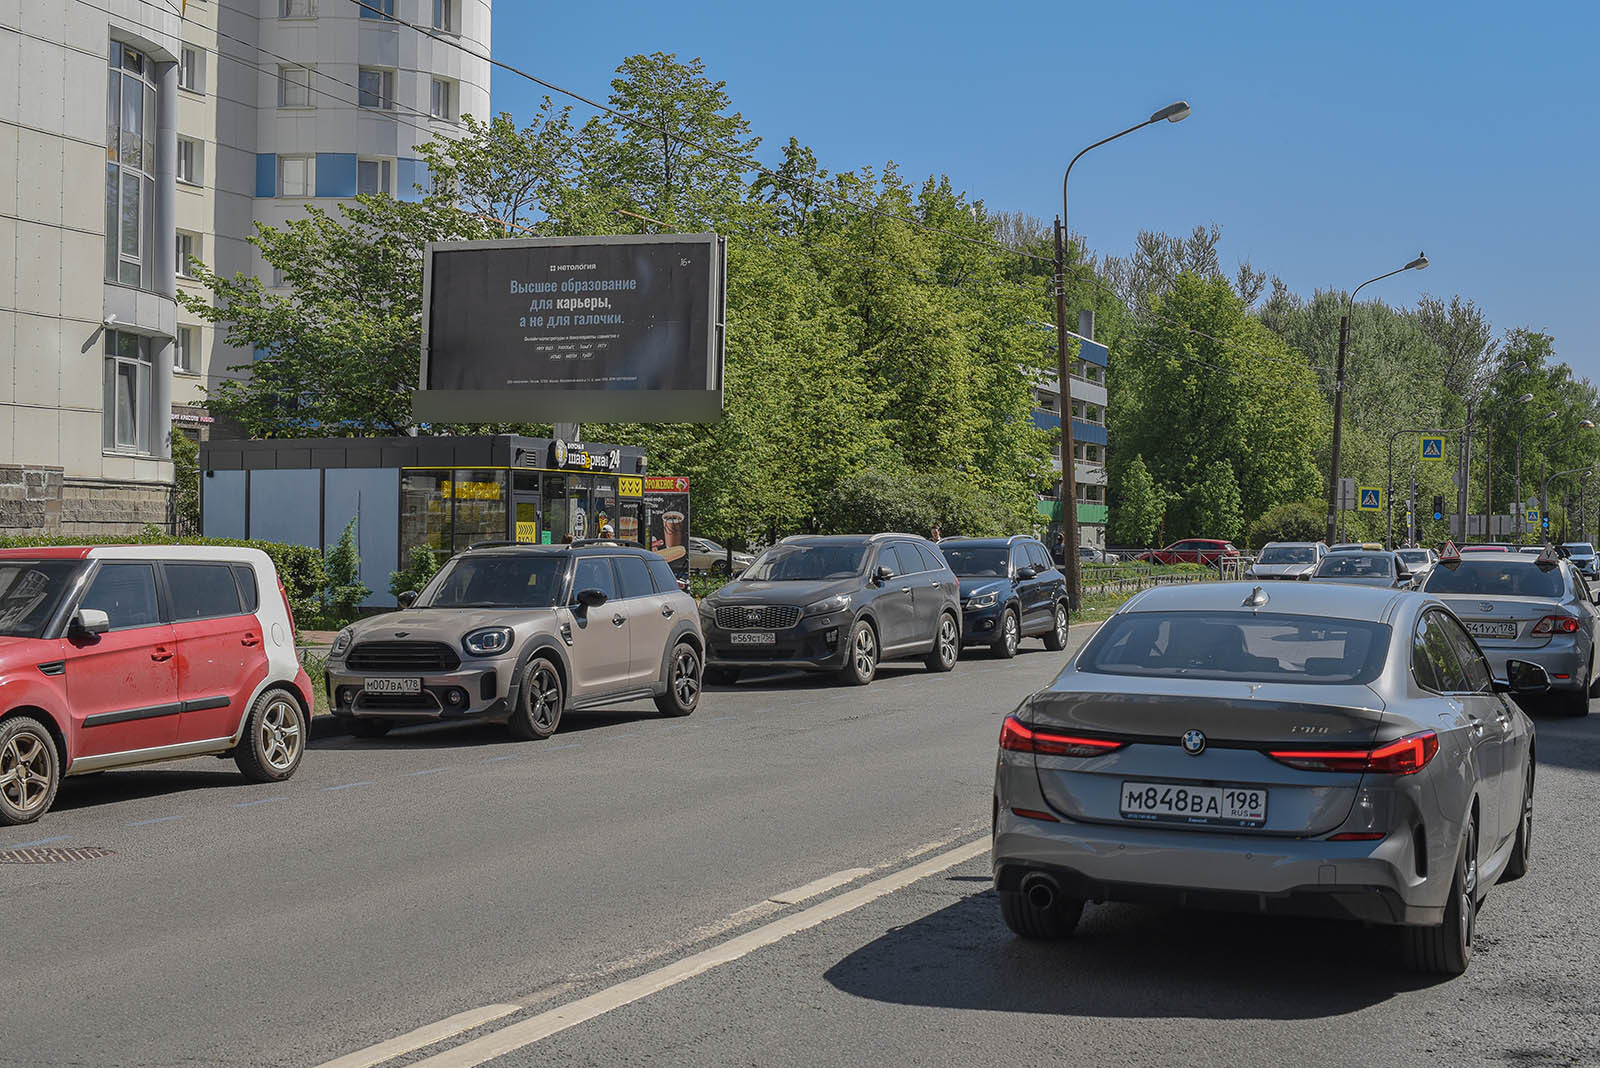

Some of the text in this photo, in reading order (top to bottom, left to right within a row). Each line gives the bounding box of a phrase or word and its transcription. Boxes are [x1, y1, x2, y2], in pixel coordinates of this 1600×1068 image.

[510, 277, 637, 295] Высшее образование
[529, 295, 612, 312] для карьеры,
[519, 313, 625, 329] а не для галочки.
[609, 449, 621, 470] 24
[367, 680, 418, 690] М007ВА 178
[1127, 786, 1260, 814] М848ВА 198
[1231, 809, 1249, 817] RUS
